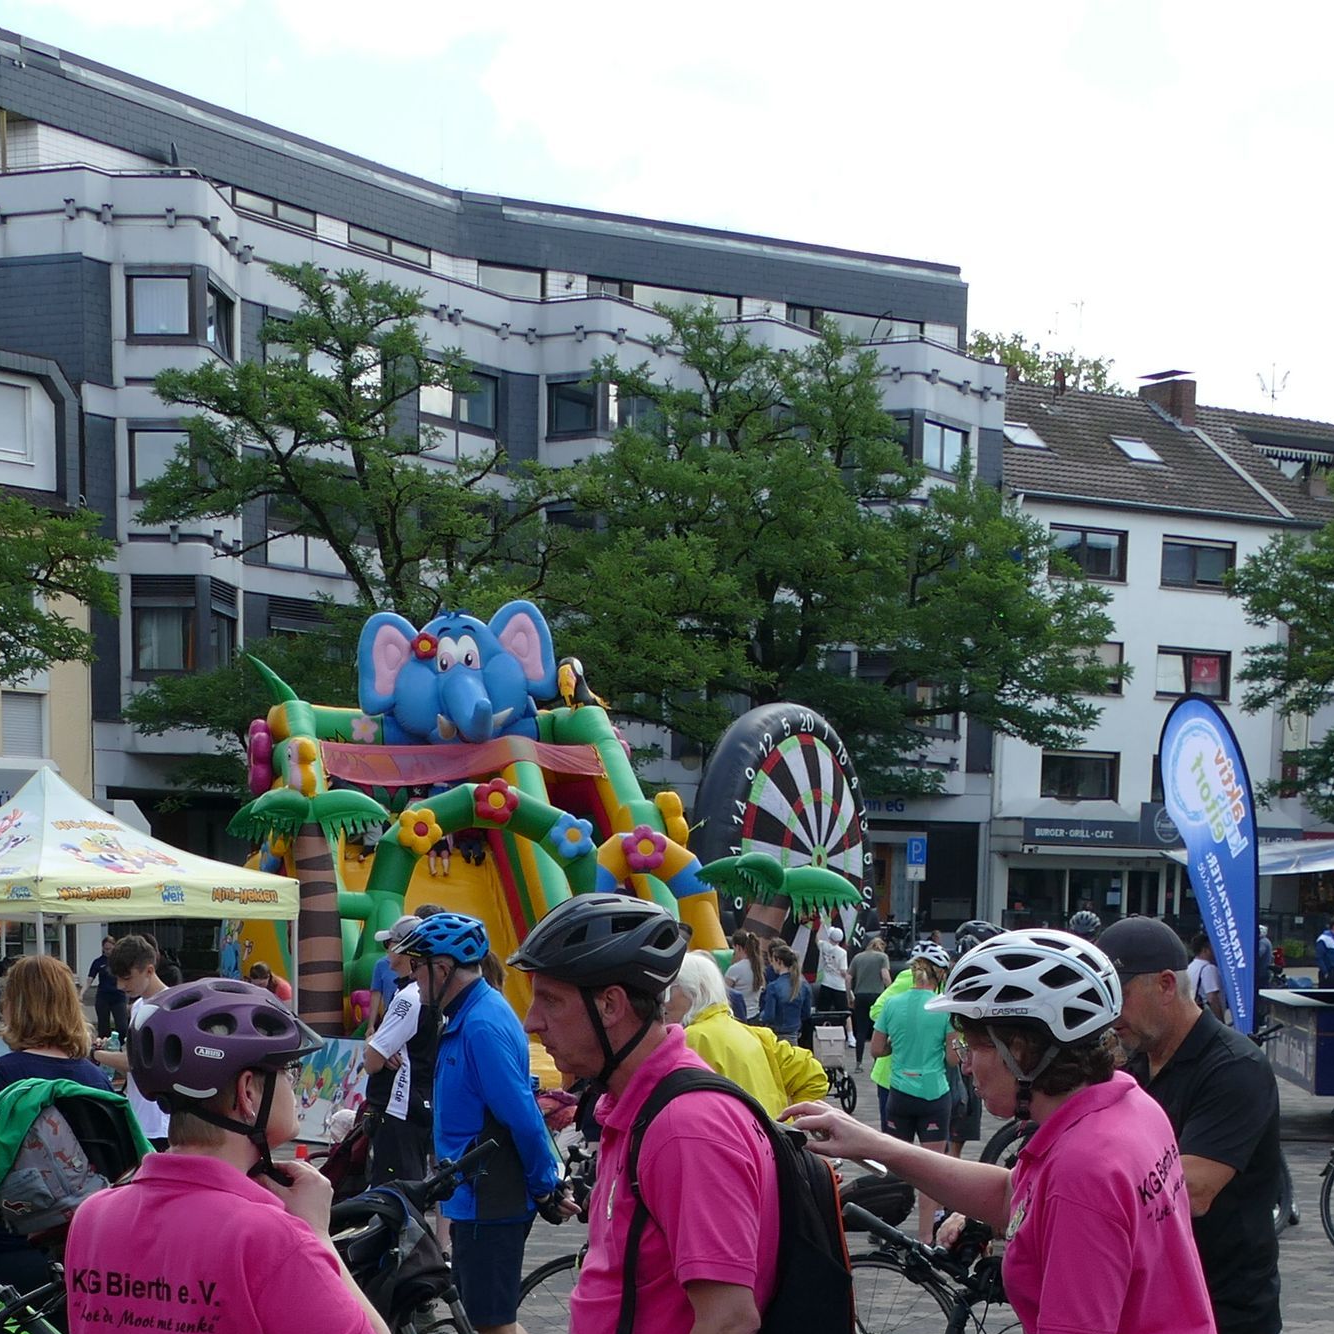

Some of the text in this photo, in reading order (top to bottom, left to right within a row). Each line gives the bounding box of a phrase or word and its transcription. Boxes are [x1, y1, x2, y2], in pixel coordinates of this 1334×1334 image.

[781, 717, 791, 736] 5
[800, 712, 815, 733] 20
[823, 722, 830, 740] 1
[758, 732, 775, 756] 12
[837, 741, 848, 766] 18
[745, 766, 756, 785] 9
[850, 776, 859, 790] 4
[732, 799, 748, 825] 14
[886, 798, 904, 812] eG
[912, 841, 922, 862] P
[862, 886, 873, 910] 10
[852, 922, 867, 949] 15
[198, 1048, 221, 1058] ABUS
[1137, 1171, 1163, 1207] KG
[72, 1268, 220, 1307] KG Bierth e.V.
